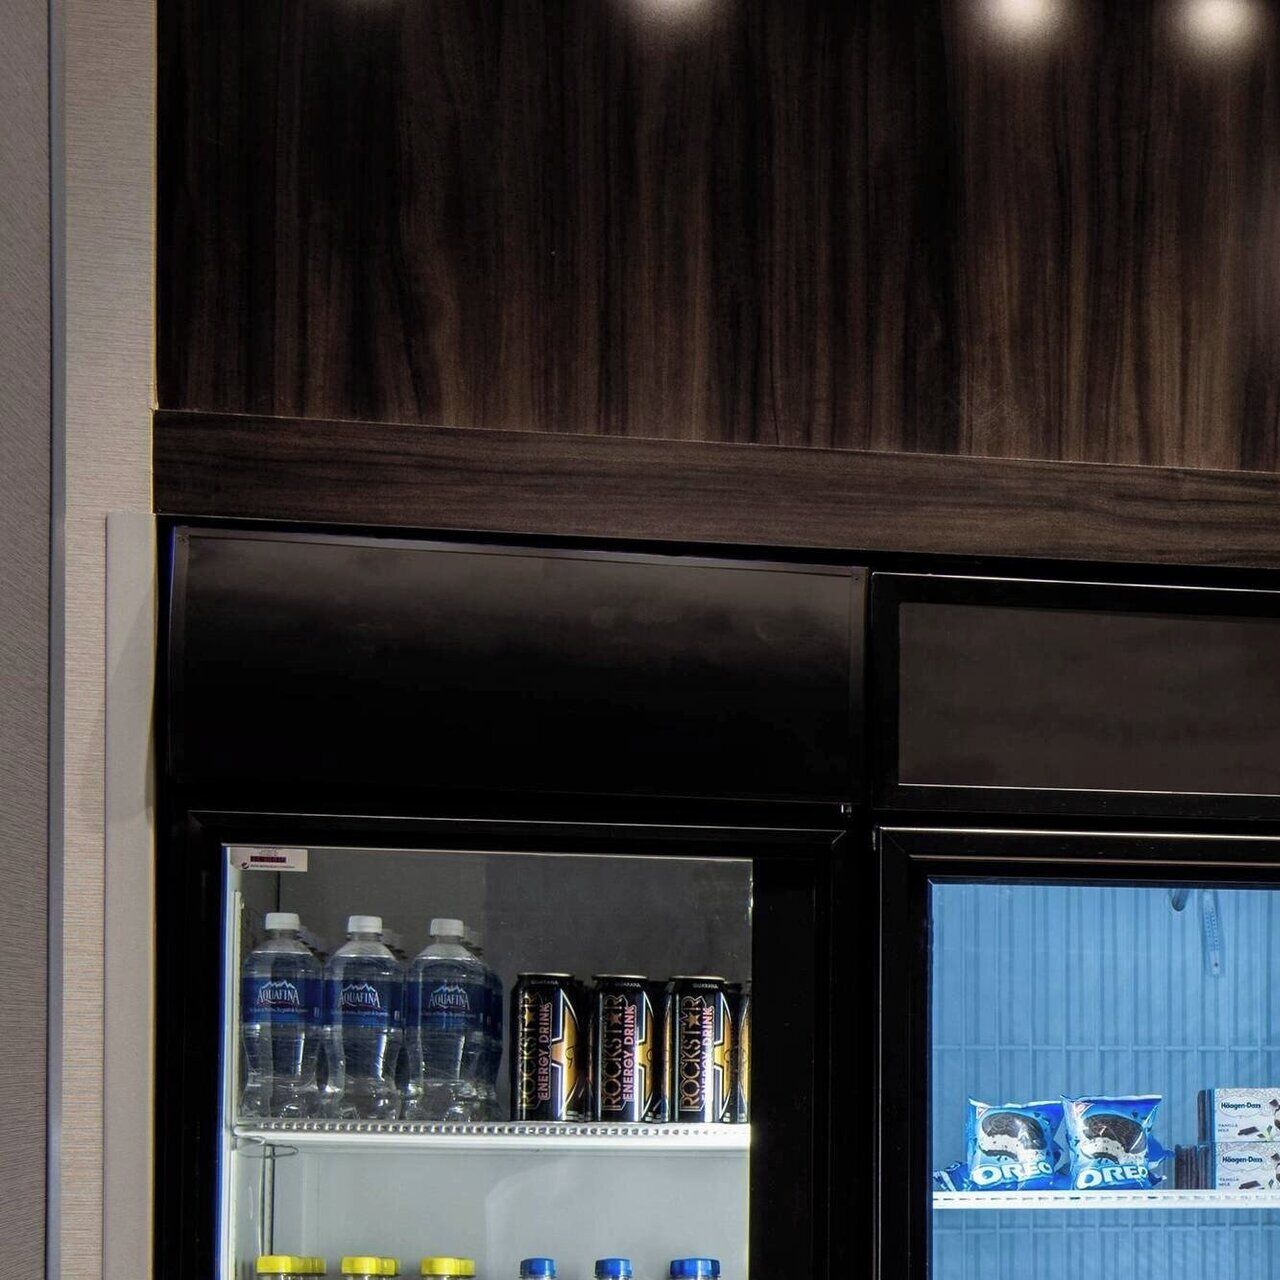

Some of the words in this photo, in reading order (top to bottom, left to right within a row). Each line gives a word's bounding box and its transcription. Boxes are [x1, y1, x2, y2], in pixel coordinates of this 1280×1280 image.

[257, 989, 300, 1005] AQUAFINA
[340, 989, 381, 1008] AQUAFINA
[429, 992, 471, 1009] AQUAFINA
[623, 1006, 636, 1045] DRINK
[701, 1006, 714, 1045] DRINK
[601, 994, 624, 1111] ROCKSTAR
[681, 995, 702, 1110] ROCKSTAR
[536, 1054, 551, 1100] ENERGY
[622, 1054, 635, 1100] ENERGY
[971, 1161, 1051, 1186] OREO
[1075, 1165, 1150, 1190] OREO
